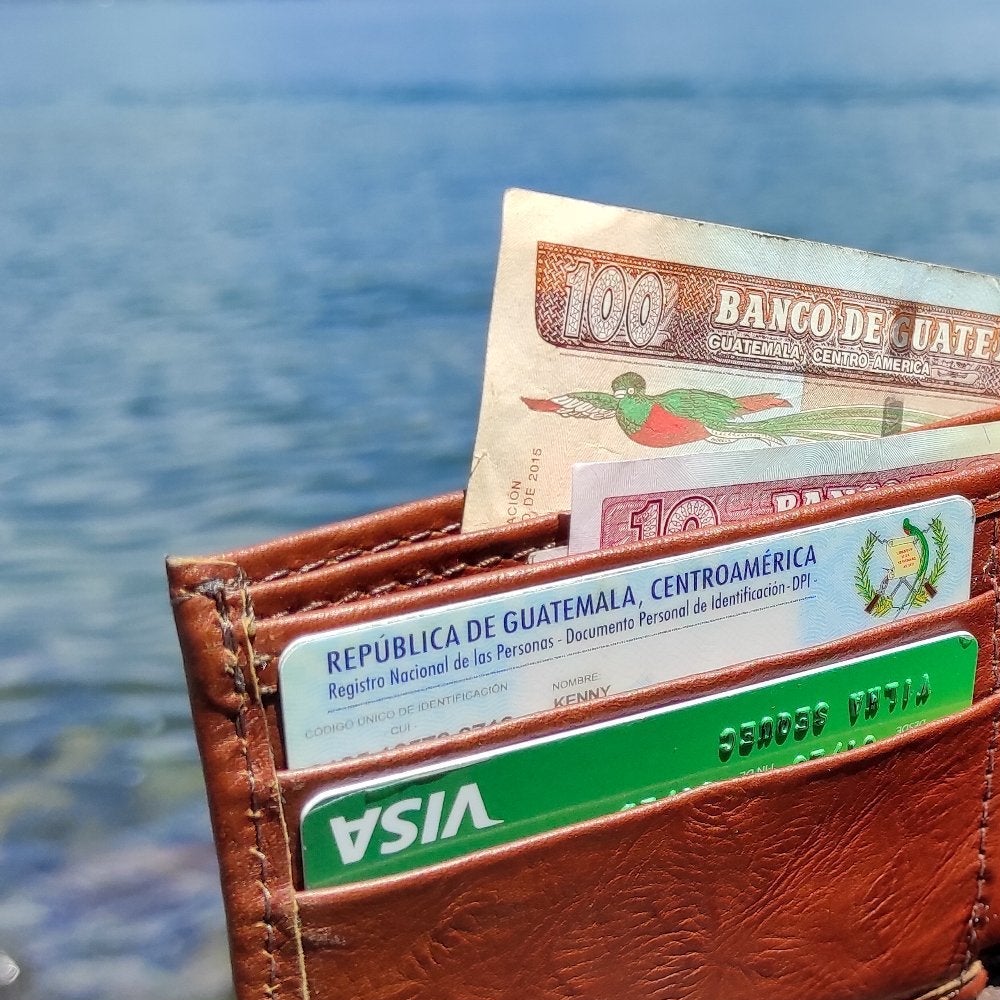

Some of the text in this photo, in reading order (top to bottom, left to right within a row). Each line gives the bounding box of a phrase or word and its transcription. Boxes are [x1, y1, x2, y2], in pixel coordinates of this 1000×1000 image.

[562, 260, 664, 348] 100
[713, 289, 833, 338] BANCO
[840, 307, 884, 346] DE
[707, 333, 805, 362] GUATEMALA,
[528, 448, 543, 482] 2015
[523, 487, 536, 506] DE
[327, 544, 817, 675] REPÚBLICA DE GUATEMALA, CENTROAMÉRICA
[328, 676, 385, 701] Registro
[390, 655, 449, 686] Nacional
[453, 653, 470, 671] de
[473, 646, 493, 667] las
[496, 635, 554, 662] Personas
[566, 614, 635, 645] Documento
[639, 600, 690, 629] Personal
[693, 600, 708, 615] de
[792, 572, 812, 592] DPI
[552, 672, 599, 691] NOMBRE
[553, 684, 612, 708] KENNY
[398, 705, 415, 717] DE
[329, 782, 505, 866] VISA
